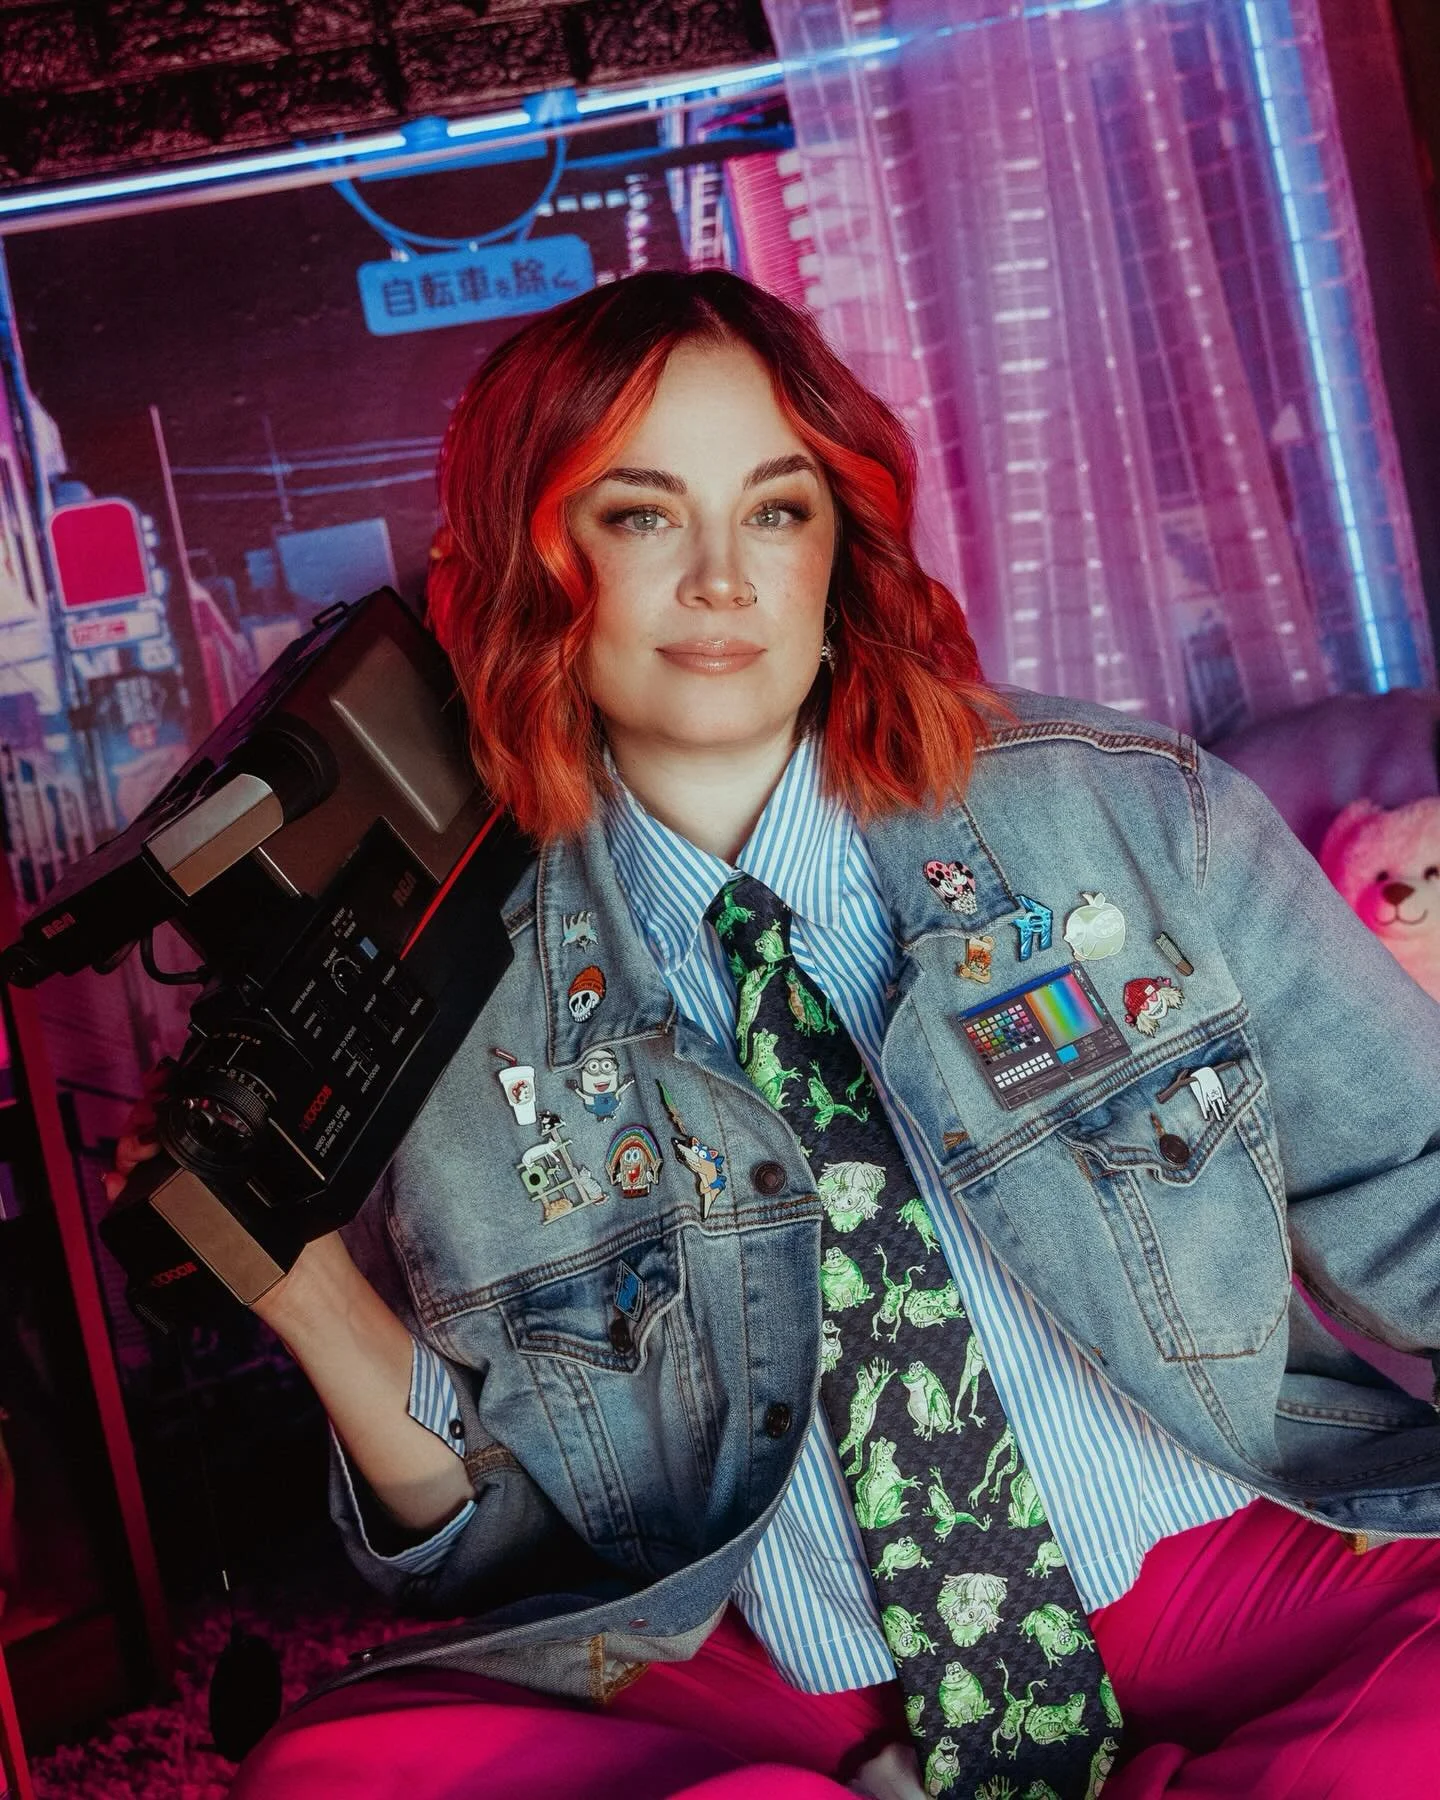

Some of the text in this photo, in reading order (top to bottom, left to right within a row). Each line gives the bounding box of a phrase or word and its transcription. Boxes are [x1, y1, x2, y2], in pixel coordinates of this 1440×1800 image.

[382, 258, 577, 317] 自転車を除く
[392, 871, 417, 907] RCA
[41, 912, 76, 939] RCA
